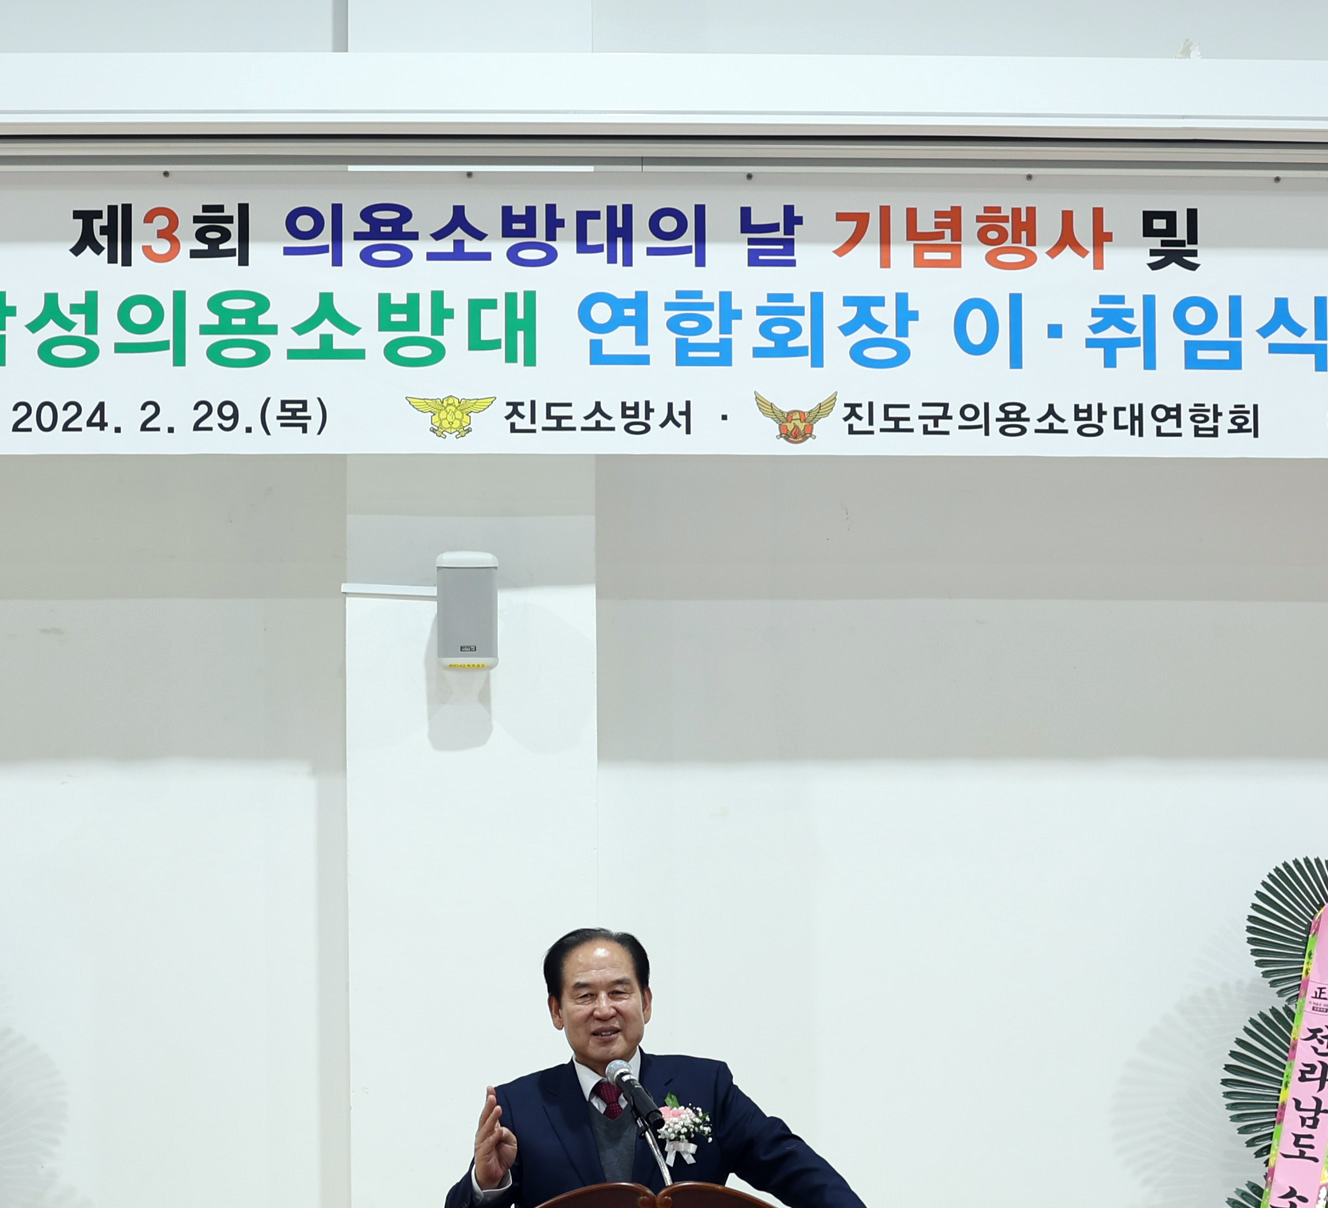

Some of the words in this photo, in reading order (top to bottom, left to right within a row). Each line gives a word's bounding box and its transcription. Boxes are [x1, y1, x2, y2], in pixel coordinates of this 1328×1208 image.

[69, 203, 251, 267] 제3회
[283, 203, 707, 268] 의용소방대의
[740, 204, 804, 268] 날
[834, 205, 1113, 271] 기념행사
[1142, 207, 1201, 271] 및
[576, 289, 920, 369] 연합회장
[12, 401, 122, 434] 2024.
[503, 400, 694, 436] 진도소방서
[841, 400, 1261, 440] 진도군의용소방대연합회
